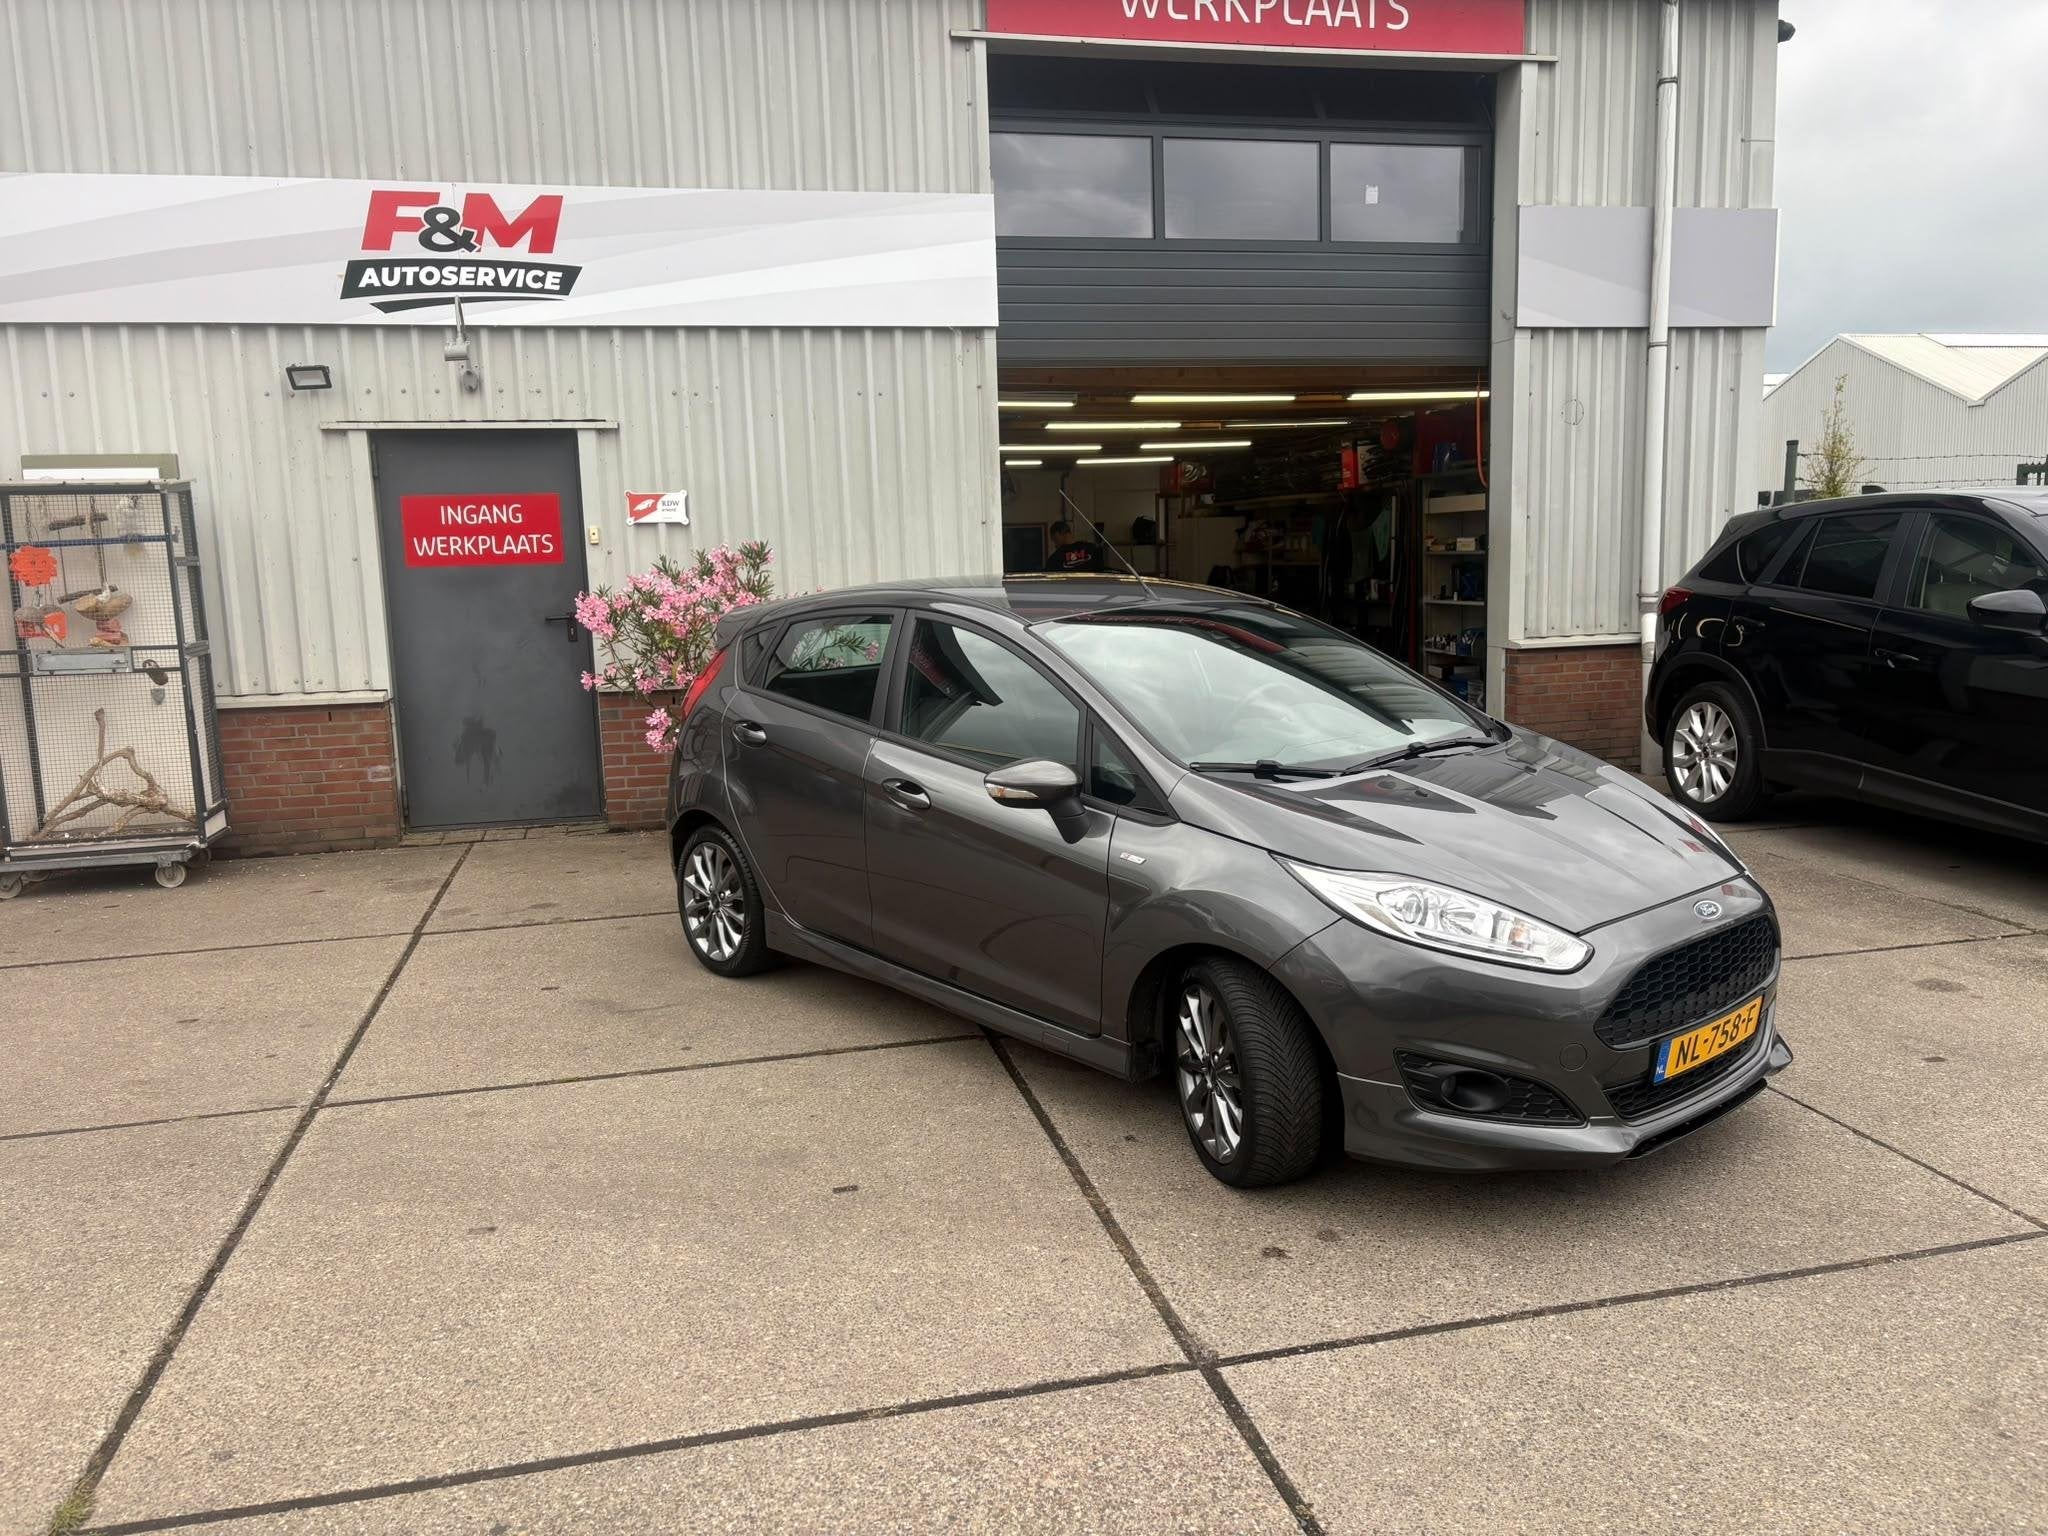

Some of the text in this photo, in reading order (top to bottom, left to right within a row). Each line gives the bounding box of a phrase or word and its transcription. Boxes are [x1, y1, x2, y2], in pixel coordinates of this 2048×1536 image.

[361, 190, 564, 254] F&M
[358, 266, 563, 290] AUTOSERVICE
[440, 504, 522, 525] INGANG
[413, 534, 554, 556] WERKPLAATS
[1675, 1003, 1757, 1069] NL-758-F
